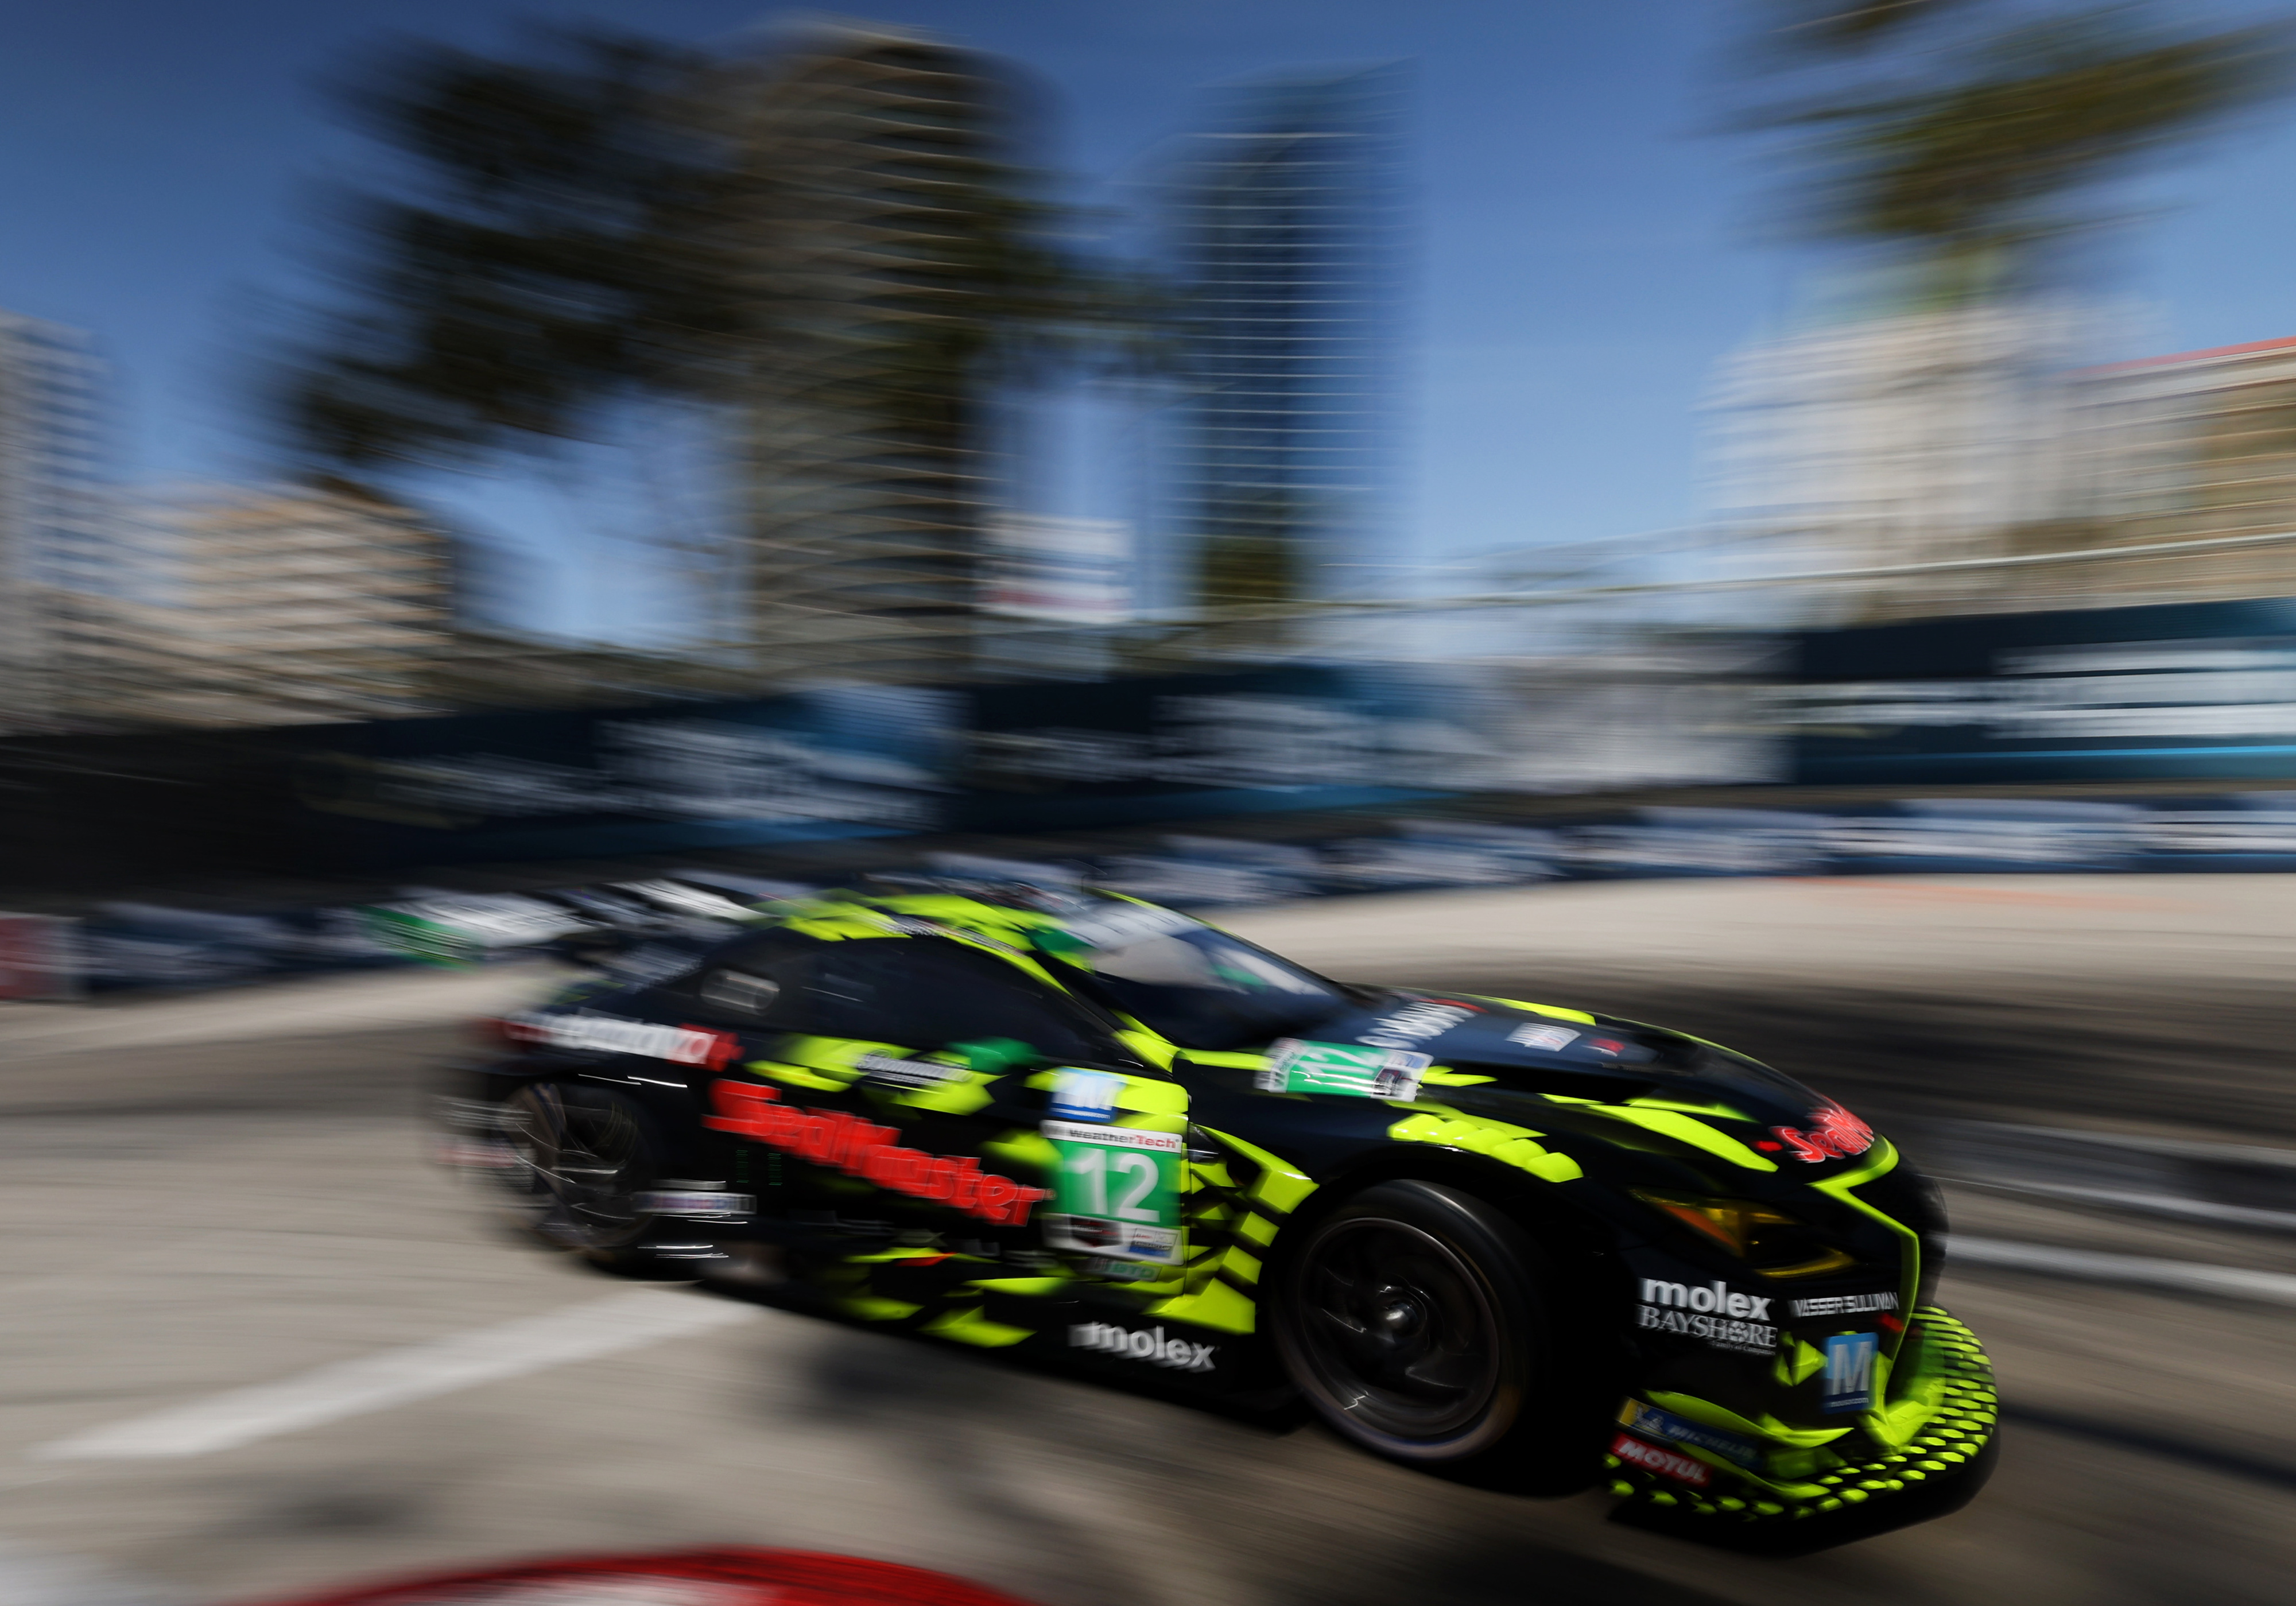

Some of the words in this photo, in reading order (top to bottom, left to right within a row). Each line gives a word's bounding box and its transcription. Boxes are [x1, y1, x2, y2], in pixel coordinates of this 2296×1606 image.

[1069, 1128, 1176, 1149] WeatherTech
[1068, 1147, 1161, 1223] 12
[1640, 1278, 1771, 1321] molex
[1791, 1297, 1844, 1318] VASSER
[1844, 1291, 1899, 1313] SULLIVAN
[1069, 1321, 1217, 1373] molex
[1636, 1304, 1778, 1347] BAYSHORE
[1829, 1341, 1873, 1395] M
[1618, 1440, 1707, 1483] MOTUL
[1667, 1424, 1757, 1458] MICHELIN
